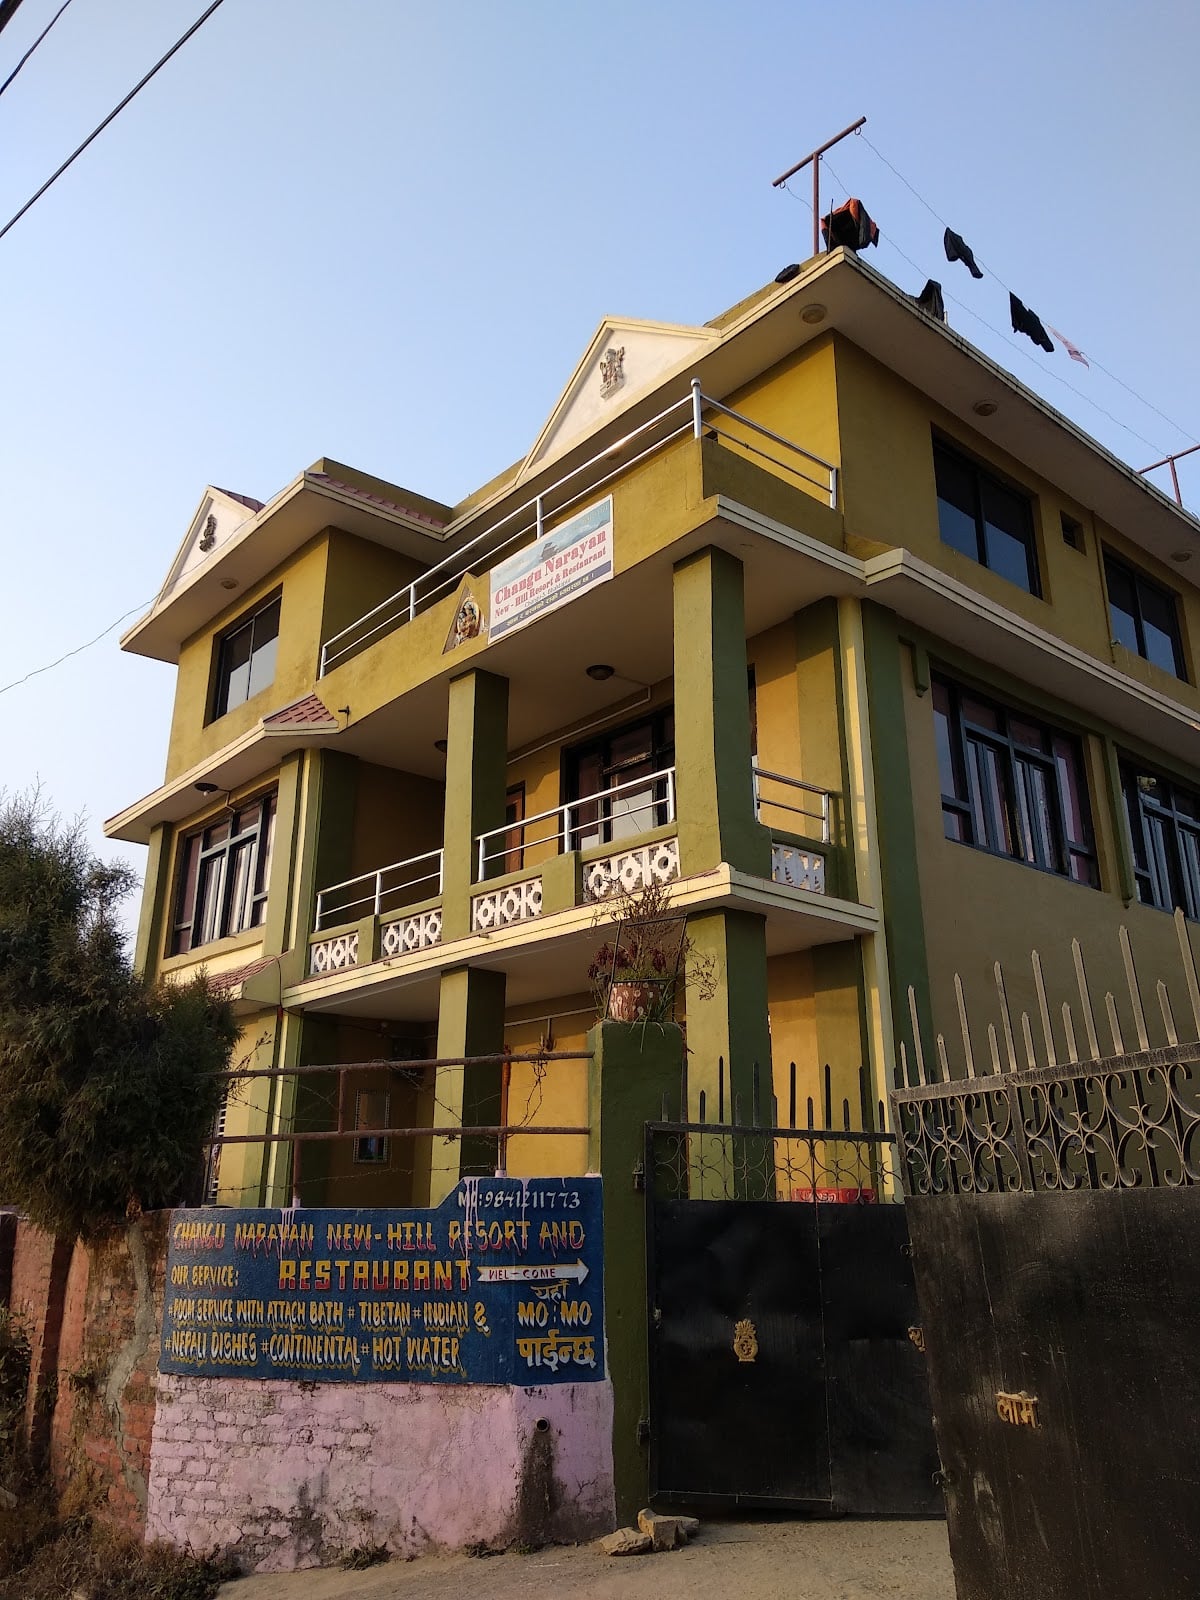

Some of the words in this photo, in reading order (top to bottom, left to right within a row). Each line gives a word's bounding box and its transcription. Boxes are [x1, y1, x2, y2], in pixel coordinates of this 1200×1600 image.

[495, 570, 542, 606] Changu
[545, 530, 606, 577] Narayan
[515, 591, 528, 607] Hill
[530, 579, 553, 599] Resort
[554, 573, 561, 584] &
[562, 546, 606, 578] Restaurant
[173, 1222, 226, 1254] CHANGU
[234, 1223, 314, 1258] NARAYAN
[448, 1220, 532, 1257] RESORT
[539, 1220, 586, 1257] AND
[170, 1265, 190, 1289] OUR
[278, 1259, 471, 1291] RESTAURANT
[196, 1298, 233, 1325] SERVICE
[236, 1299, 264, 1325] WITH
[267, 1300, 306, 1328] ATTACH
[309, 1300, 344, 1329] BATH
[358, 1301, 411, 1330] TIBETAN
[423, 1301, 468, 1329] INDIAN
[210, 1331, 258, 1362] DISHES
[372, 1337, 401, 1365] HOT
[406, 1336, 464, 1369] WATER
